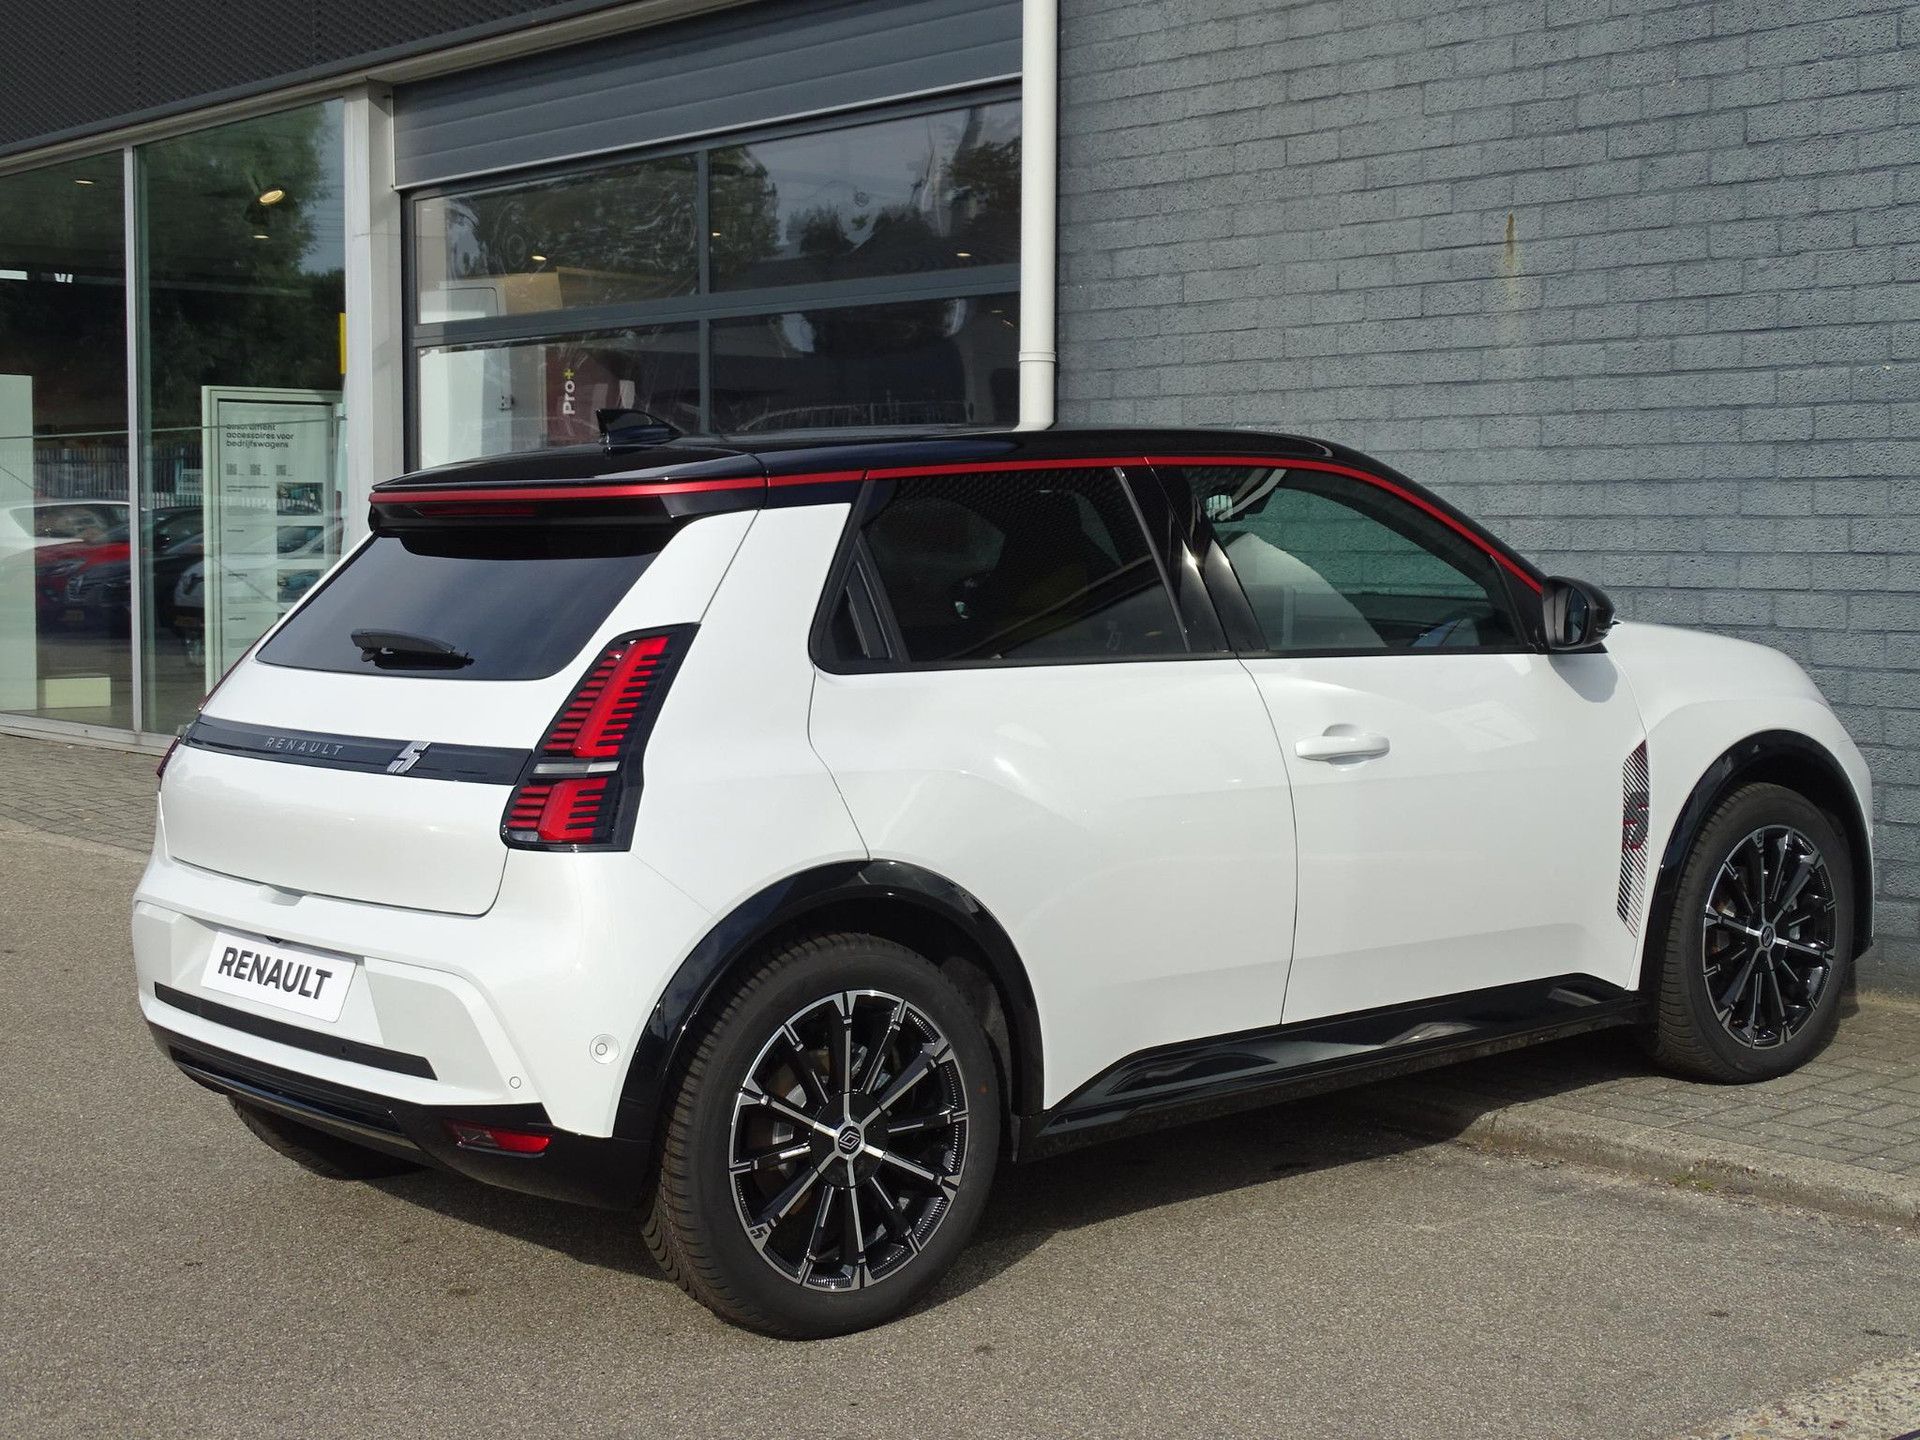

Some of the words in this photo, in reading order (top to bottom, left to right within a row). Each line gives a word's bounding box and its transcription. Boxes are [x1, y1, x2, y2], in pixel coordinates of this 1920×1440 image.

[562, 368, 575, 415] Pro+
[226, 432, 275, 440] accessoires
[226, 440, 289, 449] bedrijfswagens
[265, 737, 344, 755] RENAULT
[218, 946, 333, 1000] RENAULT
